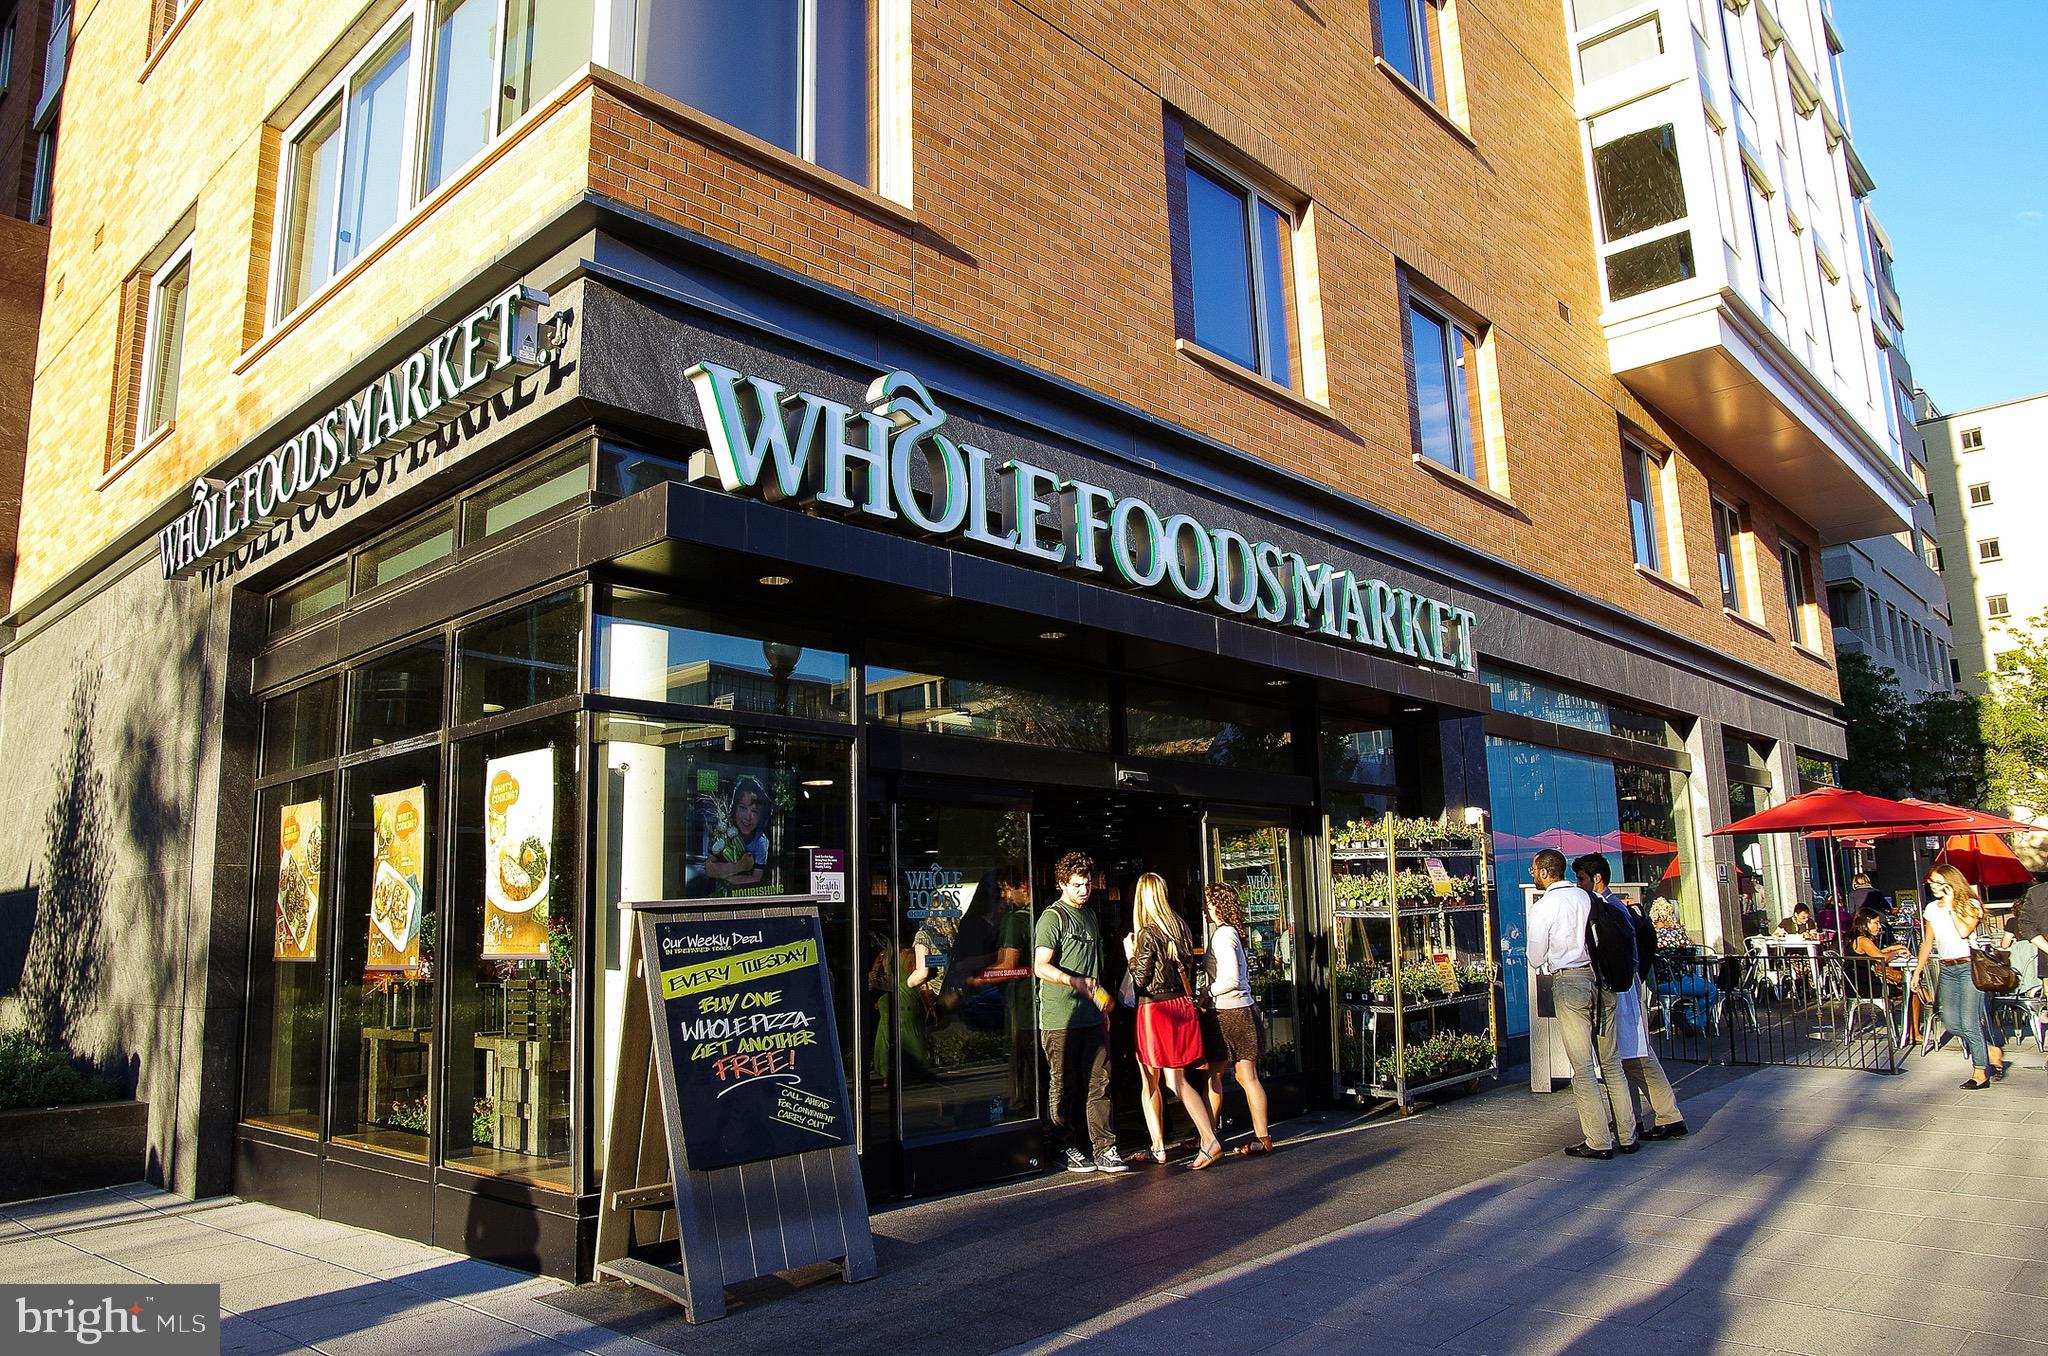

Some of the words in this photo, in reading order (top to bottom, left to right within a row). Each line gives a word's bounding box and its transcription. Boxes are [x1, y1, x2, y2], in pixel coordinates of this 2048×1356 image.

[241, 408, 339, 530] FOODS
[342, 283, 524, 465] MARKET
[684, 359, 1066, 562] WHOLE
[1066, 479, 1287, 624] FOODS
[1284, 552, 1478, 673] MARKET
[816, 880, 839, 891] health
[905, 863, 963, 890] WHOLE
[731, 884, 785, 897] NOURISHING
[908, 891, 962, 909] FOODS
[662, 937, 687, 951] Our
[686, 934, 730, 949] Weekly
[731, 930, 763, 946] Deal
[668, 965, 730, 992] EVERY
[736, 946, 808, 975] TUESDAY
[698, 993, 740, 1014] BUY
[741, 990, 782, 1009] ONE
[681, 1015, 752, 1041] WHOLE
[748, 1011, 816, 1034] PIZZA
[691, 1039, 734, 1061] GET
[737, 1029, 818, 1054] ANOTHER
[711, 1048, 796, 1081] FREE!
[777, 1098, 793, 1110] FOR
[792, 1103, 836, 1124] CONVENIENT
[781, 1089, 803, 1101] CALL
[804, 1096, 830, 1110] AHEAD
[777, 1109, 807, 1124] CARRY
[806, 1118, 828, 1130] OUT
